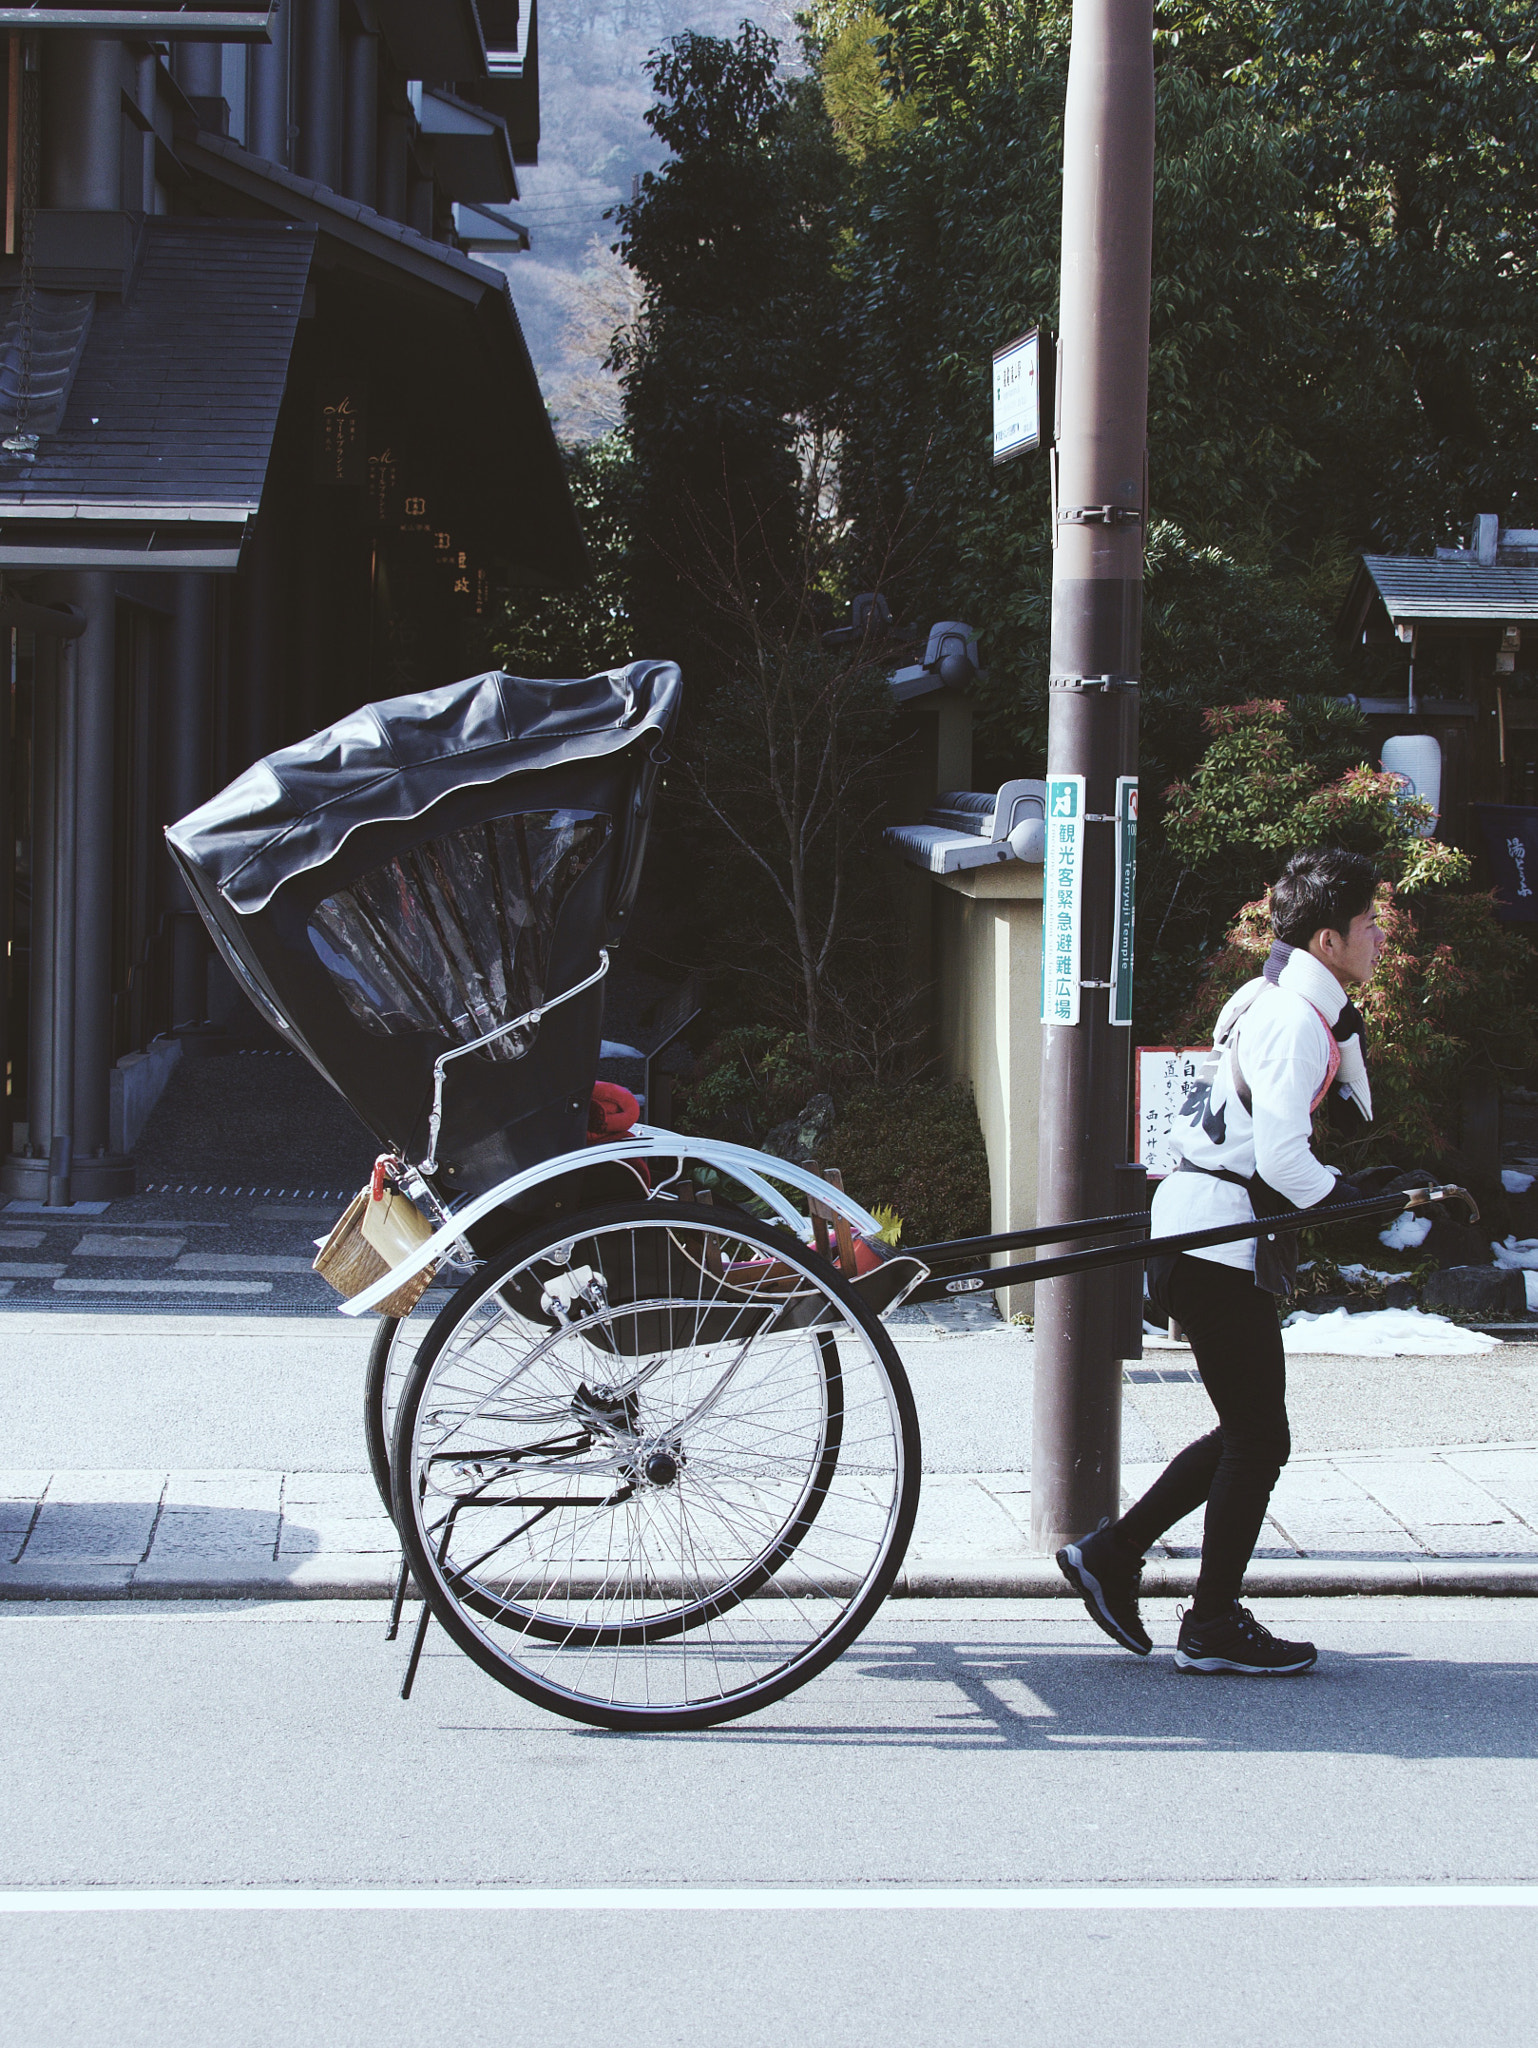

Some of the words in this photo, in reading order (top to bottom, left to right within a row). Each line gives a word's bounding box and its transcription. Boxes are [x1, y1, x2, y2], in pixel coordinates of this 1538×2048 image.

[1122, 862, 1132, 914] Tenryuji
[1054, 823, 1075, 1019] 観光客緊急避難広場
[1121, 919, 1130, 970] Temple
